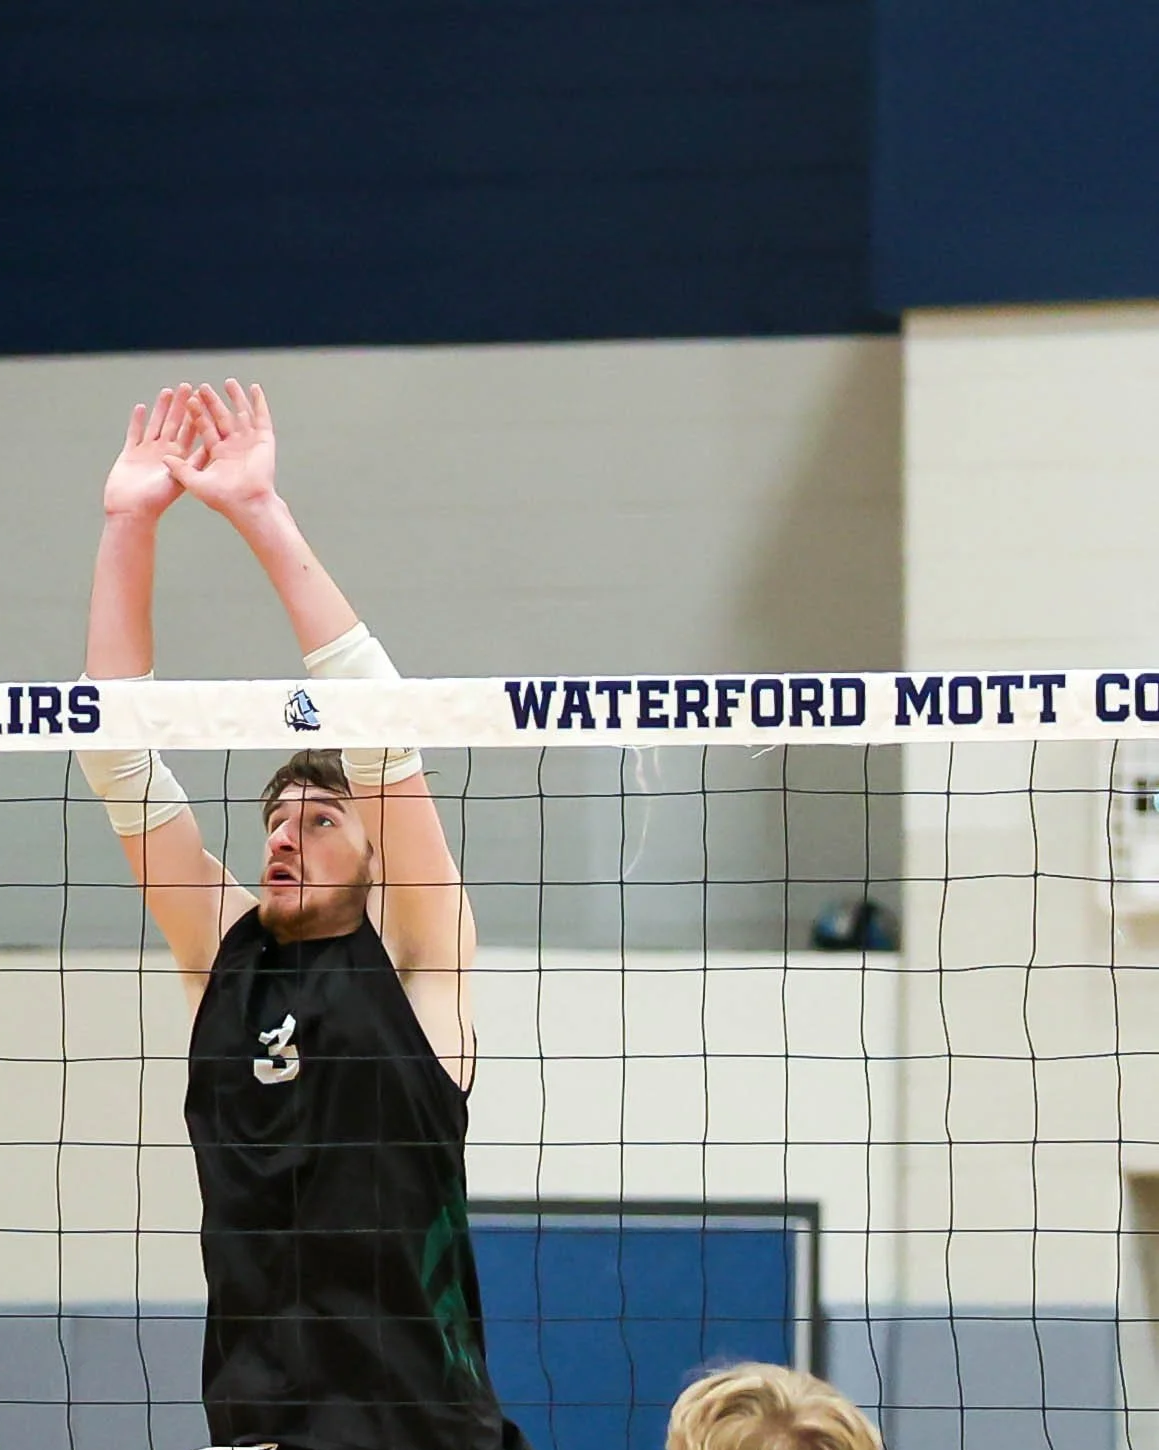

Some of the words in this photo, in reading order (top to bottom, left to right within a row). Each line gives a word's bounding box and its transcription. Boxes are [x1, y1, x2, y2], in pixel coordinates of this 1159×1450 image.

[504, 680, 866, 729] WATERFORD
[895, 674, 1066, 725] MOTT
[253, 1014, 300, 1085] 3
